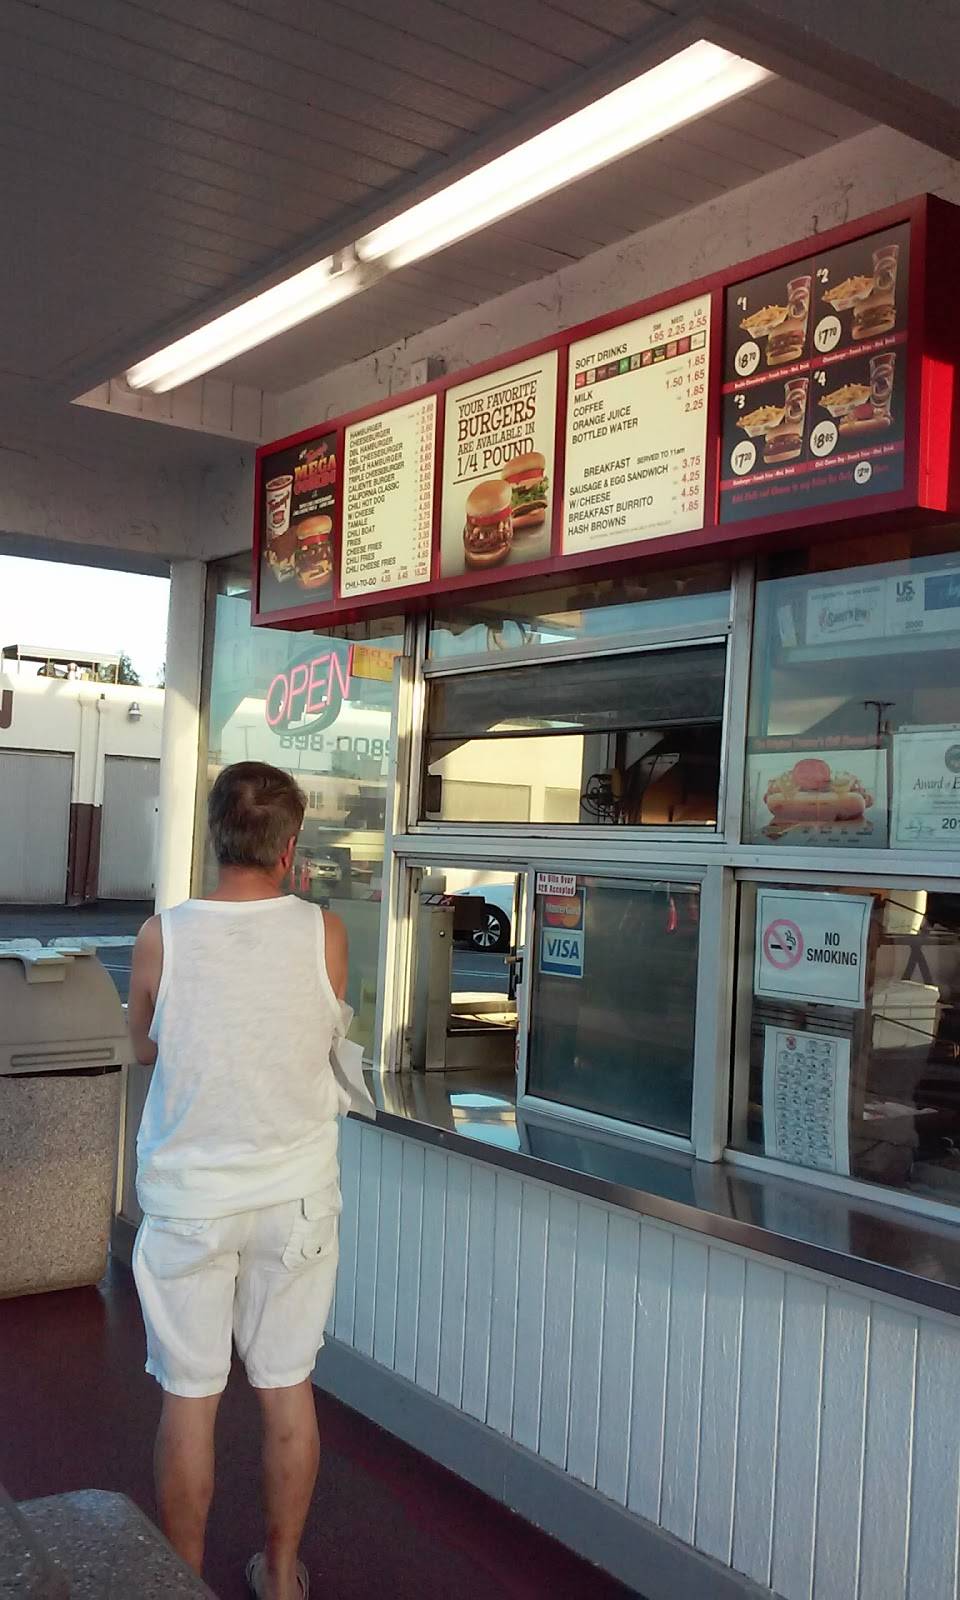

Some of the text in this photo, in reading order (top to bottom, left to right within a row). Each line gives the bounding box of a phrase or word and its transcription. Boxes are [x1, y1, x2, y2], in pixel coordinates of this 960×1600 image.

[816, 268, 829, 283] #2
[649, 315, 707, 344] 1.95 2.25 2.55
[575, 343, 628, 369] SOFT DRINKS
[814, 371, 827, 386] #4
[458, 380, 537, 418] YOUR FAVORITE
[573, 400, 604, 418] COFFEE
[665, 376, 683, 389] 1.50
[574, 391, 593, 404] MILK
[734, 394, 745, 409] #3
[457, 395, 536, 442] BURGERS
[572, 413, 606, 431] ORANGE
[607, 405, 631, 421] JUICE
[572, 399, 704, 445] BOTTLED WATER 2.25
[349, 428, 391, 448] CHEESEBURGER
[350, 421, 382, 439] HAMBURGER
[457, 421, 535, 456] ARE AVAILABLE IN
[349, 449, 359, 458] DBL
[360, 436, 393, 454] HAMBURGER
[360, 442, 403, 462] CHEESEBURGER
[457, 437, 534, 477] 1/4 POUND
[294, 454, 336, 476] MEGA
[348, 463, 366, 475] TRIPLE
[366, 452, 403, 469] HAMBURGER
[348, 472, 365, 484] TRIPLE
[365, 461, 405, 479] CHEESEBURGER
[583, 447, 686, 478] BREAKFAST SERVED TO 11am
[348, 480, 372, 494] CALIENTE
[373, 473, 395, 486] BURGER
[569, 456, 701, 496] SAUSAGE & EGG SANDWICH 3.75
[348, 488, 377, 503] CALIFORNIA
[378, 480, 400, 494] CLASSIC
[569, 471, 700, 509] W/CHEESE 4.25
[348, 502, 361, 512] CHILI
[361, 498, 373, 508] HOT
[373, 494, 385, 505] DOG
[354, 507, 375, 519] CHEESE
[568, 485, 700, 523] BREAKFAST BURRITO 4.55
[347, 529, 361, 539] CHILI
[361, 525, 375, 536] BOAT
[348, 518, 368, 529] TAMALE
[568, 524, 589, 536] HASH
[591, 516, 626, 532] BROWNS
[346, 545, 367, 557] CHEESE
[368, 541, 383, 551] FRIES
[347, 537, 361, 547] FRIES
[346, 556, 360, 566] CHILI
[360, 552, 375, 562] FRIES
[346, 564, 359, 574] CHILI
[360, 560, 380, 572] CHEESE
[381, 557, 396, 567] FRIES
[345, 577, 377, 590] CHILI-TO-GO
[265, 643, 354, 726] OPEN
[549, 885, 574, 895] Accepted
[548, 939, 580, 959] VISA
[824, 932, 841, 947] NO
[806, 947, 858, 966] SMOKING
